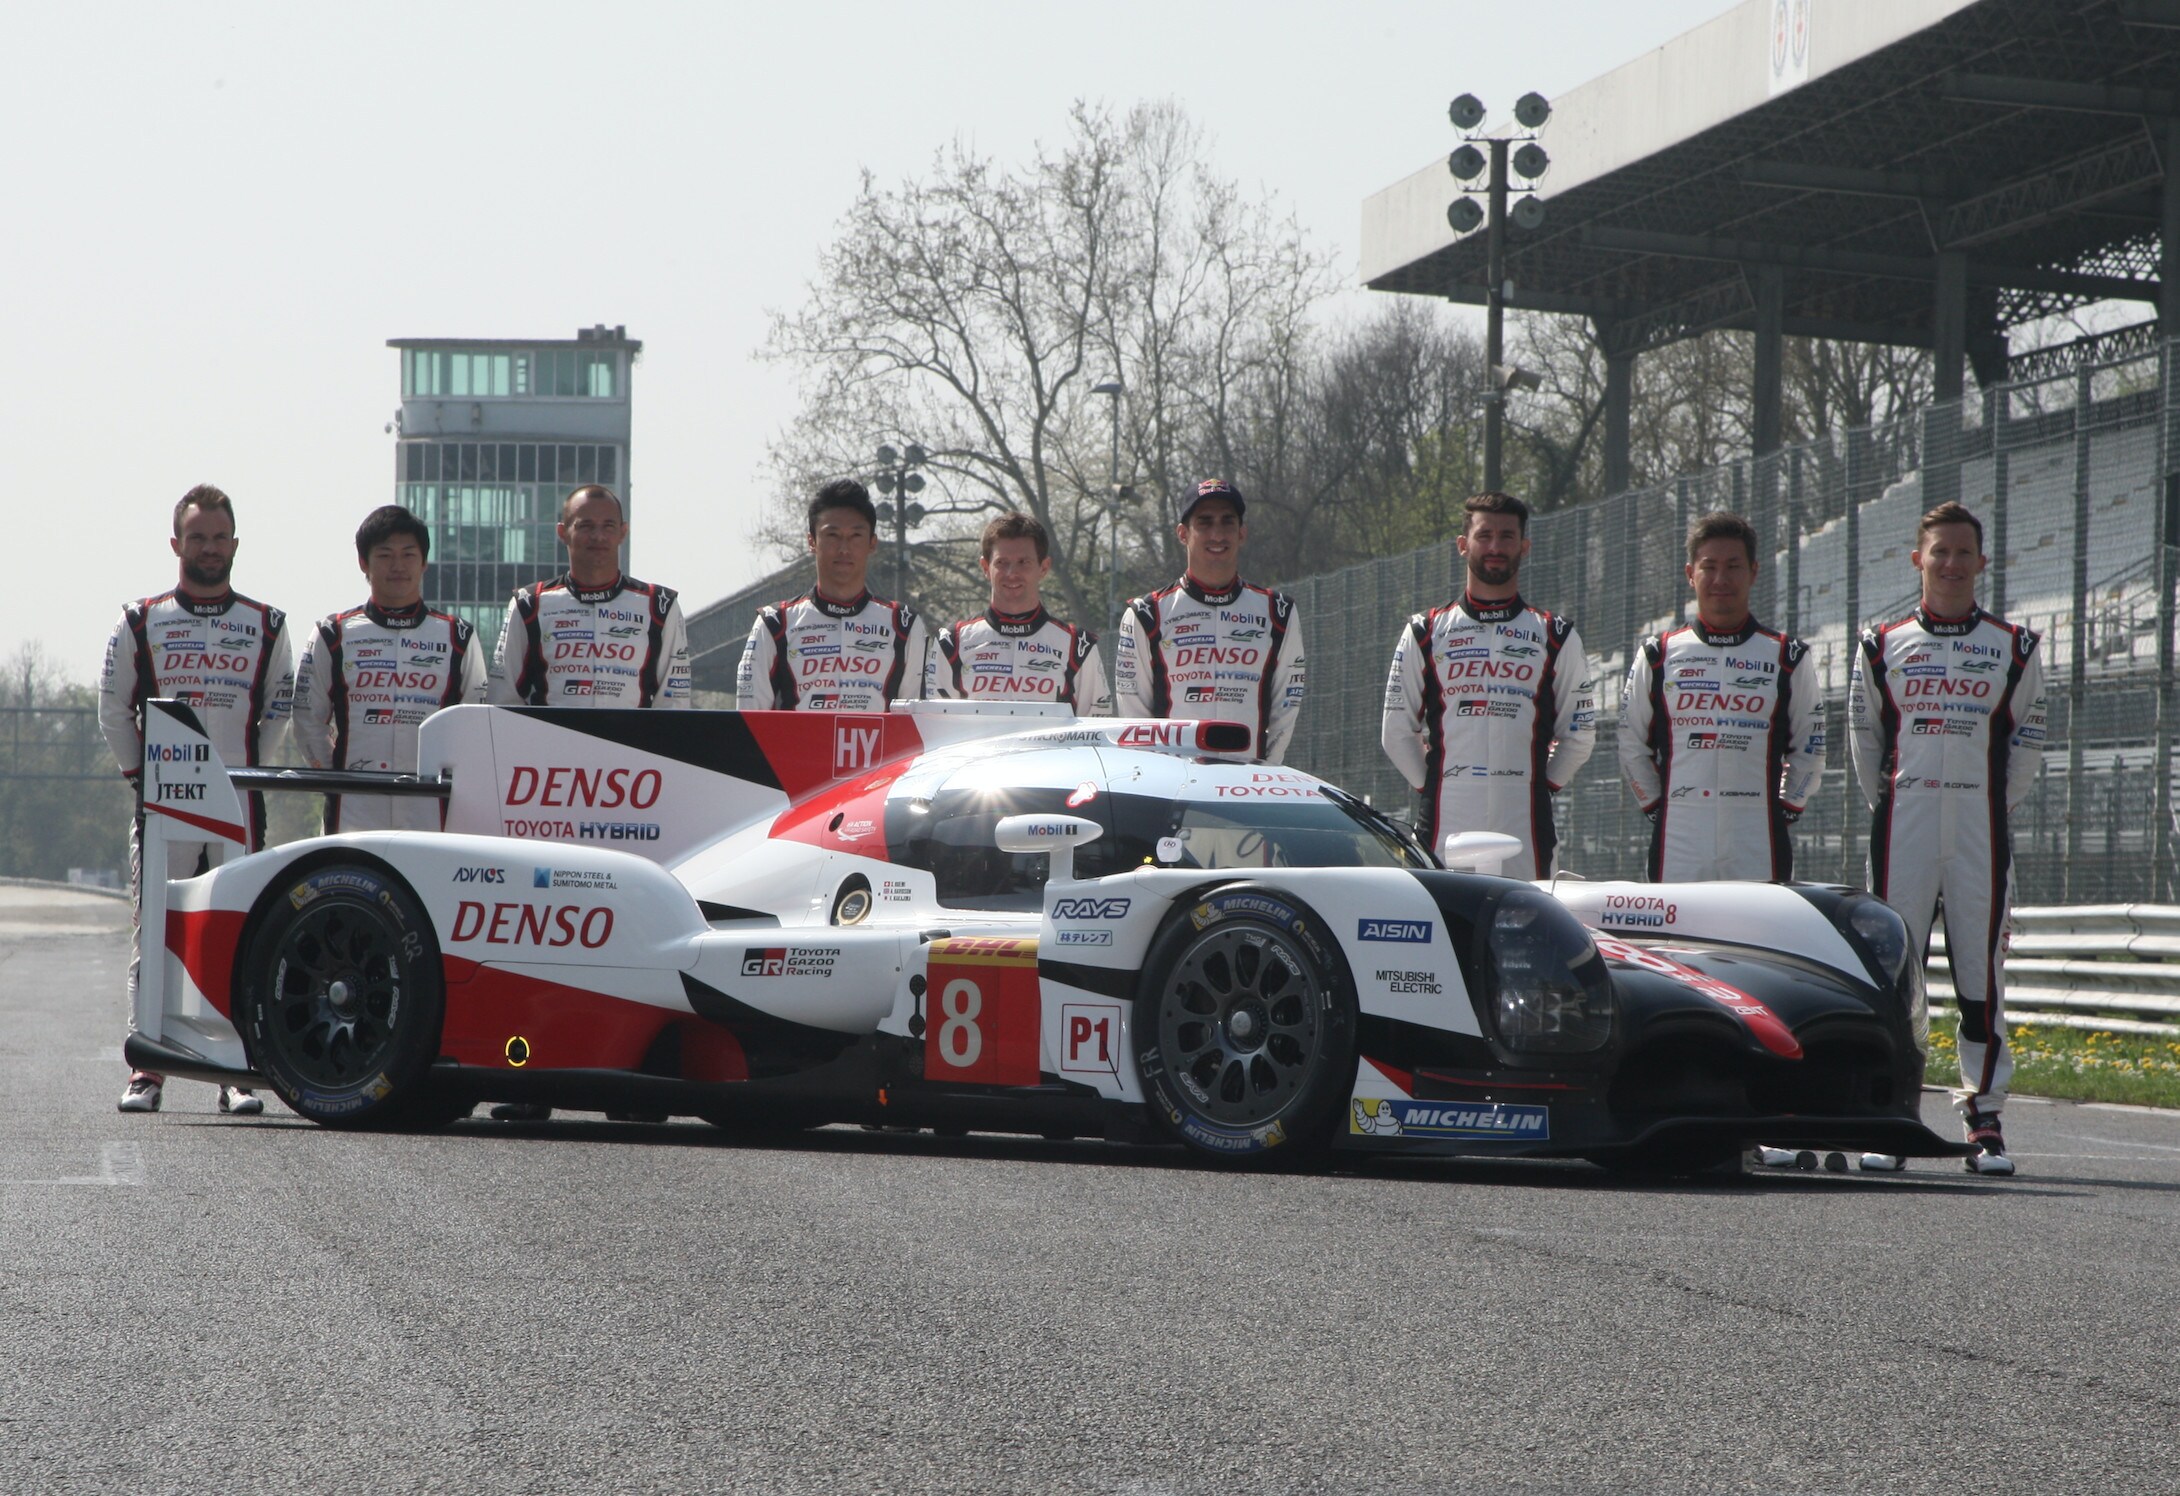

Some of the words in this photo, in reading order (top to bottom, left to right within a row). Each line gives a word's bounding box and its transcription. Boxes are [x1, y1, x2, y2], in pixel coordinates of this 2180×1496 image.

[581, 592, 605, 600] Mobil
[1205, 595, 1229, 603] Mobil
[598, 609, 631, 621] Mobil
[1220, 611, 1254, 624] Mobil
[1480, 611, 1504, 620] Mobil
[211, 619, 243, 632] Mobil
[555, 620, 580, 628] ZENT
[845, 622, 877, 635] Mobil
[1001, 625, 1025, 633] Mobil
[1175, 624, 1200, 634] ZENT
[1934, 625, 1959, 633] Mobil
[801, 635, 827, 644] ZENT
[1496, 625, 1530, 641] Mobil
[401, 638, 434, 651] Mobil
[1018, 641, 1052, 654] Mobil
[1449, 637, 1475, 648] ZENT
[1953, 641, 1987, 656] Mobil
[554, 642, 635, 661] DENSO
[975, 653, 1000, 661] ZENT
[1175, 647, 1259, 667] DENSO
[164, 653, 248, 672] DENSO
[802, 656, 881, 676] DENSO
[1726, 657, 1761, 671] Mobil
[1170, 671, 1212, 683] TOYOTA
[1447, 660, 1533, 681] DENSO
[1679, 669, 1706, 677] ZENT
[158, 675, 201, 686] TOYOTA
[355, 671, 437, 690] DENSO
[972, 676, 1054, 694] DENSO
[564, 686, 590, 695] GR
[1905, 678, 1990, 697] DENSO
[349, 693, 391, 703] TOYOTA
[1185, 693, 1212, 702] GR
[1676, 693, 1765, 713] DENSO
[810, 700, 837, 709] GR
[1458, 706, 1485, 716] GR
[364, 715, 392, 724] GR
[1672, 717, 1714, 726] TOYOTA
[1117, 722, 1191, 746] ZENT
[1913, 724, 1940, 734] GR
[836, 728, 880, 768] HY
[1688, 738, 1715, 749] GR
[148, 744, 191, 761] Mobil
[156, 783, 207, 803] JTEKT
[505, 766, 662, 809] DENSO
[1215, 786, 1323, 797] TOYOTA
[505, 820, 575, 838] TOYOTA
[580, 822, 660, 841] HYBRID
[1028, 824, 1062, 836] Mobil
[452, 867, 505, 884] ADVICS
[554, 870, 582, 879] NIPPON
[583, 871, 605, 880] STEEL
[605, 872, 612, 880] &
[318, 875, 377, 892] MICHELIN
[552, 880, 592, 888] SUMITOMO
[594, 881, 618, 890] METAL
[1052, 898, 1131, 919] RAYS
[1223, 898, 1291, 920] MICHELIN
[1606, 895, 1664, 911] TOYOTA
[1665, 904, 1677, 924] 8
[450, 901, 614, 949] DENSO
[1601, 912, 1663, 927] HYBRID
[1363, 923, 1426, 939] AISIN
[943, 938, 1021, 958] DHL
[742, 959, 783, 976] GR
[789, 948, 840, 956] TOYOTA
[788, 957, 834, 966] GAZOO
[786, 967, 832, 978] Racing
[1376, 970, 1435, 982] MITSUBISHI
[1390, 982, 1442, 994] ELECTRIC
[1729, 1005, 1768, 1016] ZENT
[938, 978, 982, 1068] 8
[1069, 1016, 1109, 1062] P1
[1404, 1108, 1542, 1130] MICHELIN
[1185, 1124, 1251, 1149] MICHELIN
